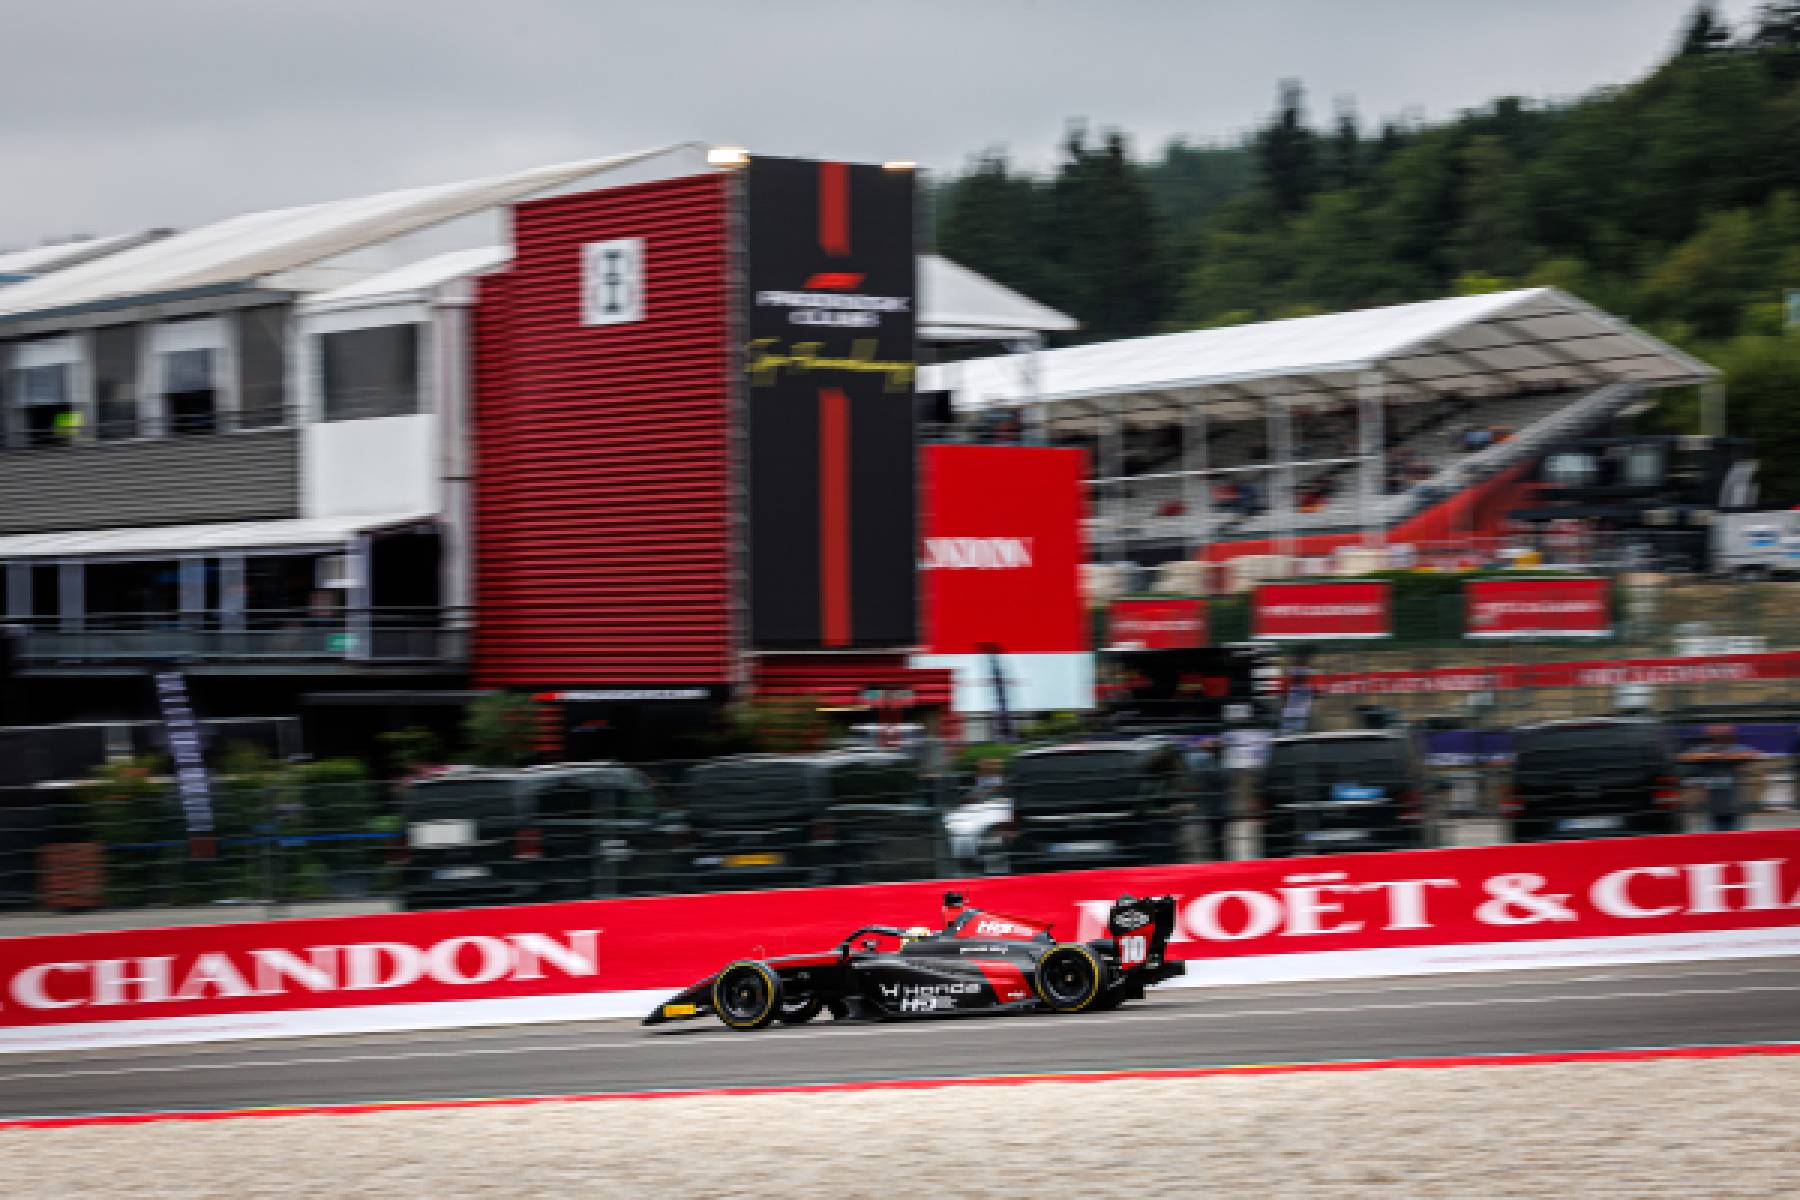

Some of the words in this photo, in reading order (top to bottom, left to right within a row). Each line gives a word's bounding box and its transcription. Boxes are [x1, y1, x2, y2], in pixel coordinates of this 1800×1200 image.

[1474, 872, 1578, 926] &
[1589, 857, 1800, 919] CH
[9, 929, 602, 1008] CHANDON
[1119, 935, 1147, 964] 10
